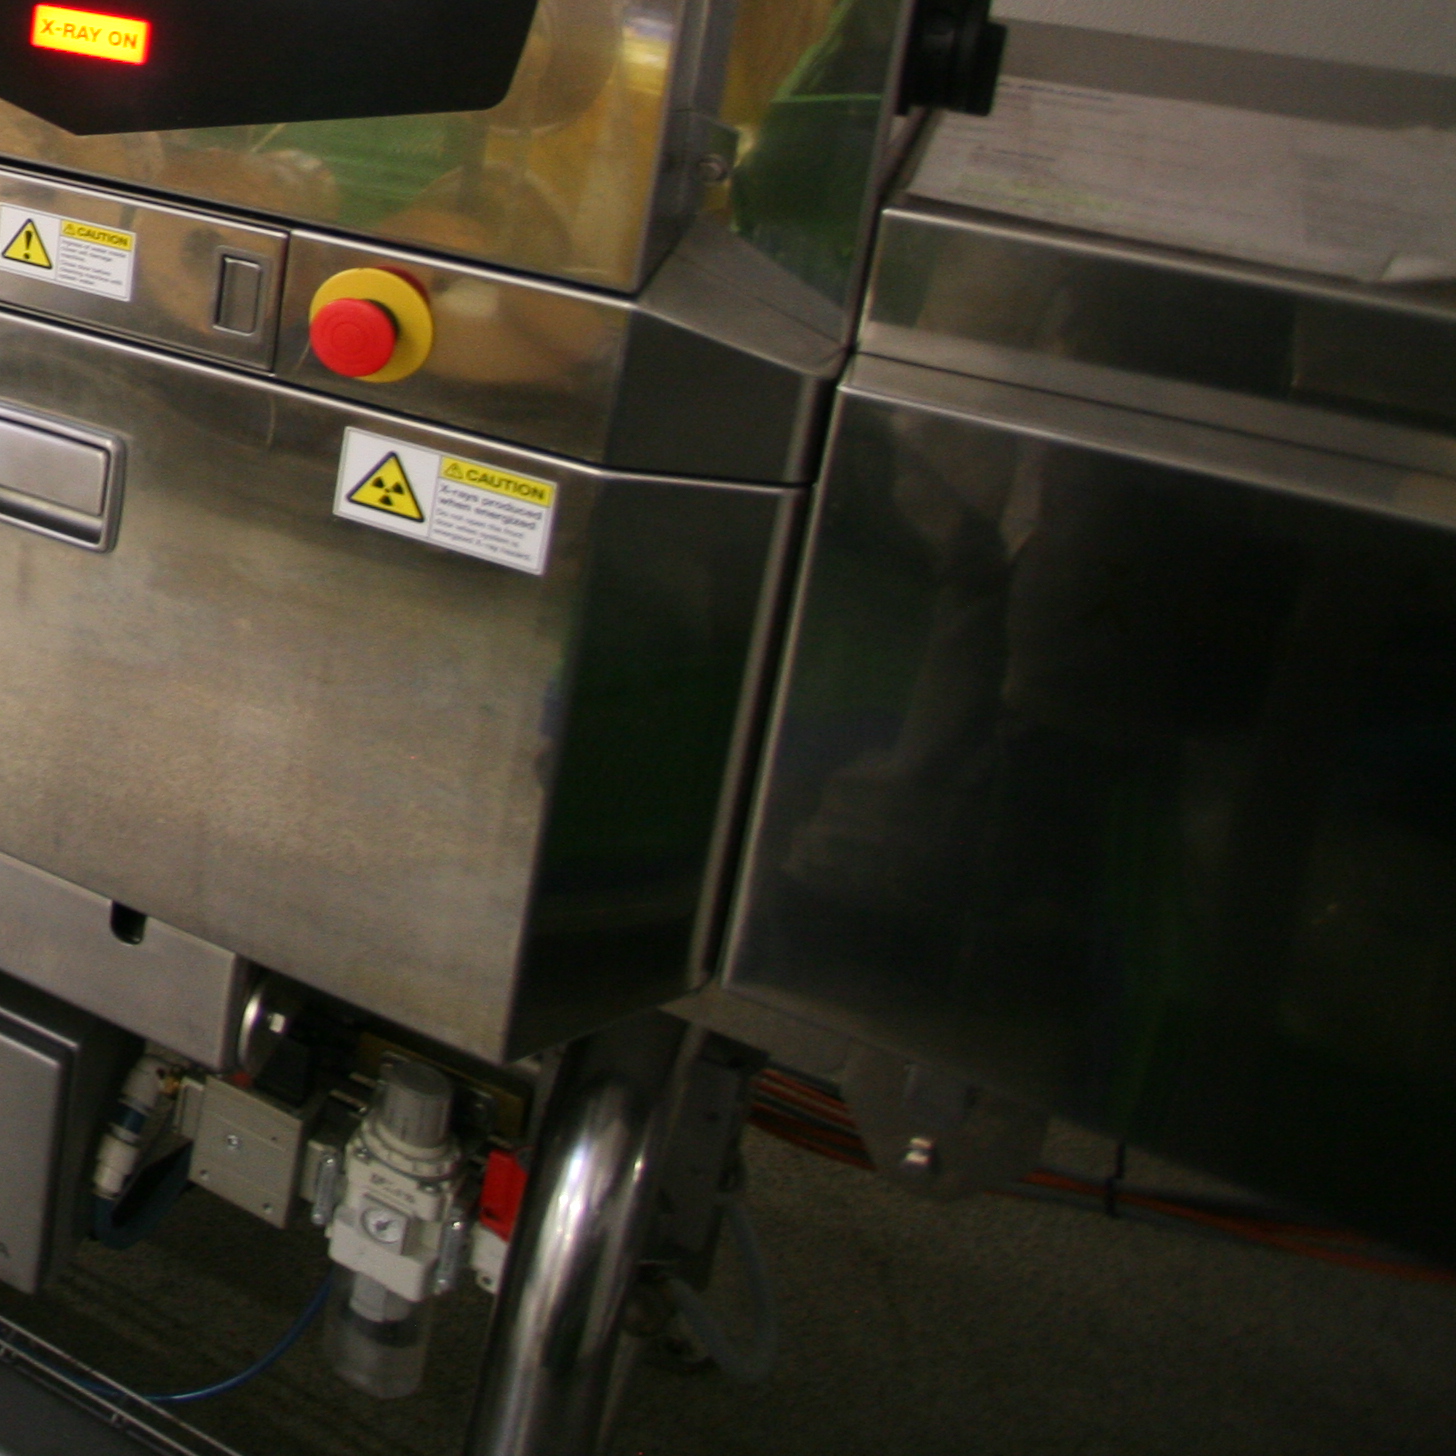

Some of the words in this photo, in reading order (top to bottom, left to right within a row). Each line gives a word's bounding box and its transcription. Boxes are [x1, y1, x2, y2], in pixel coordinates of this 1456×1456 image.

[39, 19, 102, 44] X-RAY
[108, 31, 138, 50] ON
[77, 227, 128, 246] CAUTION
[465, 469, 545, 500] CAUTION
[440, 498, 472, 511] when
[481, 497, 543, 520] produced
